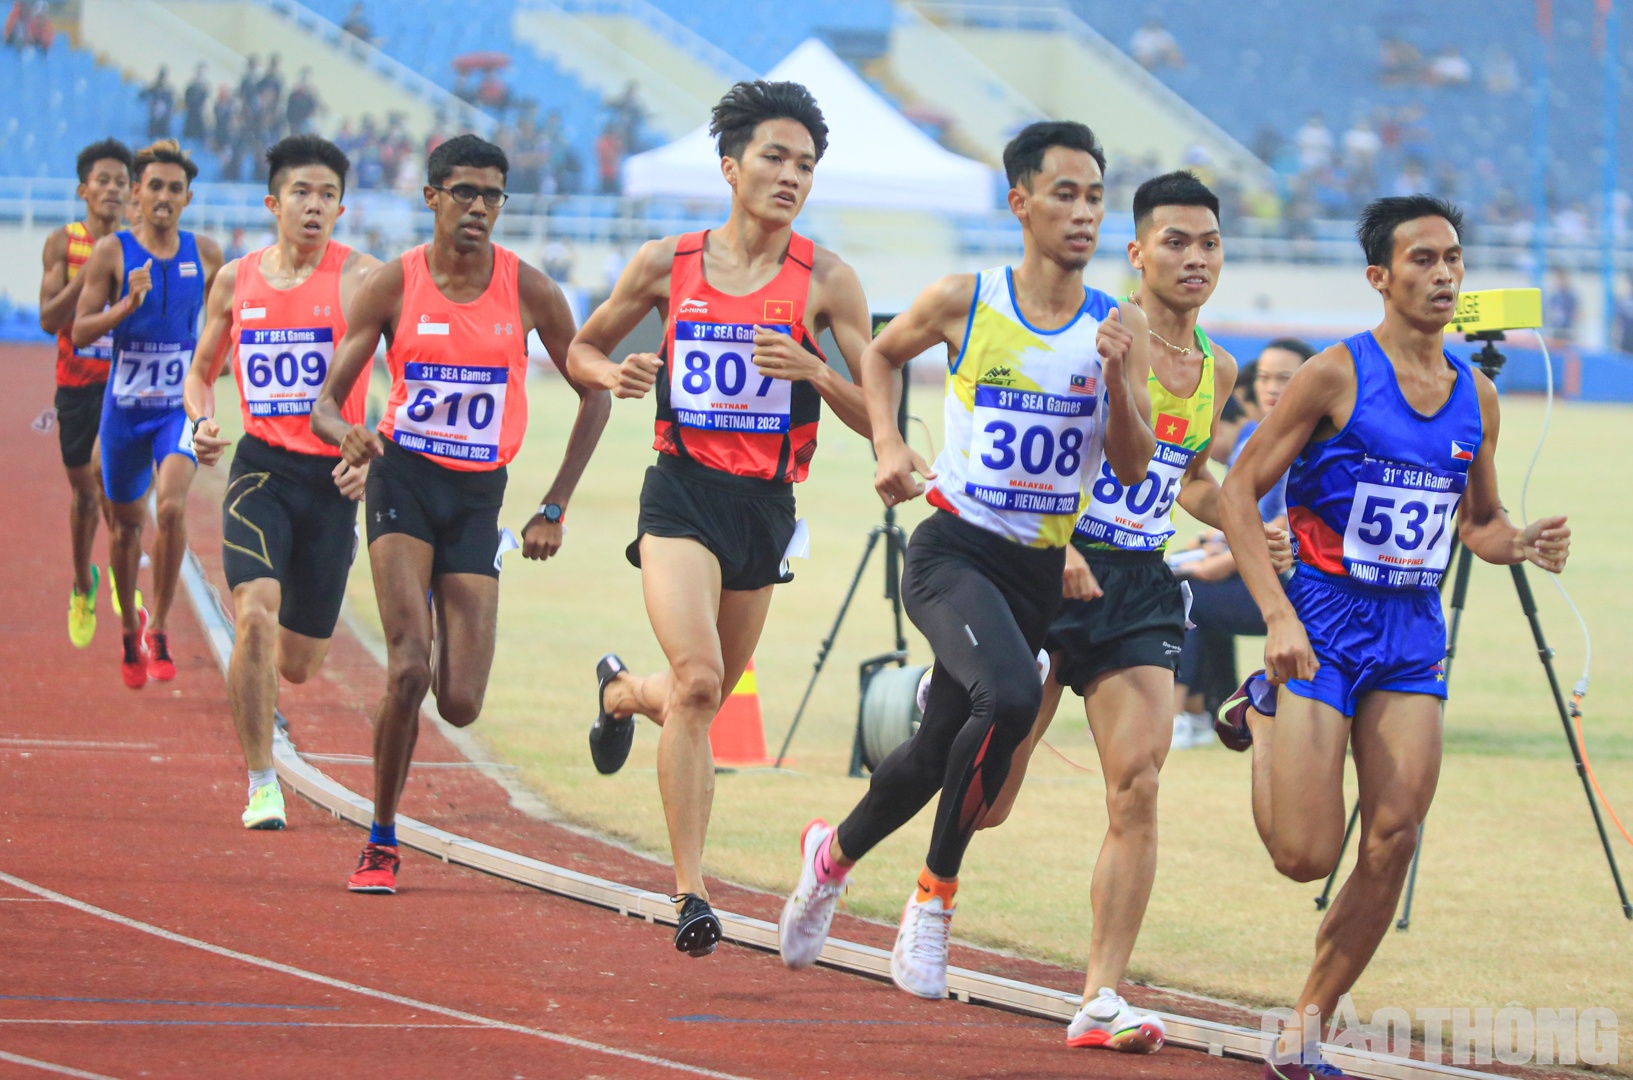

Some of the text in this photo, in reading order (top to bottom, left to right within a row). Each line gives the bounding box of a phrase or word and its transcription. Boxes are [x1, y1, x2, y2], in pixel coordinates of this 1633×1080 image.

[270, 331, 286, 342] SEA
[288, 330, 315, 342] Games
[713, 325, 733, 339] SEA
[122, 358, 184, 386] 719
[247, 351, 327, 388] 609
[440, 367, 458, 380] SEA
[461, 369, 491, 382] Games
[277, 401, 311, 414] VIETNAM
[407, 388, 495, 430] 610
[711, 402, 748, 410] VIETNAM
[1022, 394, 1044, 410] SEA
[1047, 396, 1081, 414] Games
[678, 411, 706, 427] HANOI
[714, 415, 755, 430] VIETNAM
[757, 417, 780, 430] 2022
[426, 429, 468, 440] SINGAPORE
[399, 433, 426, 450] HANOI
[432, 441, 469, 458] VIETNAM
[470, 447, 490, 459] 2022
[981, 420, 1083, 477] 308
[1162, 446, 1188, 466] Games
[1009, 480, 1054, 491] MALAYSIA
[1093, 460, 1178, 519] 805
[1403, 470, 1423, 486] SEA
[1424, 472, 1453, 489] Games
[975, 487, 1007, 505] HANOI
[1014, 493, 1056, 511] VIETNAM
[1056, 497, 1074, 511] 2022
[1076, 517, 1107, 538] HANOI
[1113, 528, 1147, 547] VIETNAM
[1358, 495, 1448, 551] 537
[1378, 554, 1424, 565] PHILIPPINES
[1350, 562, 1379, 582] HANOI
[1388, 569, 1421, 585] VIETNAM
